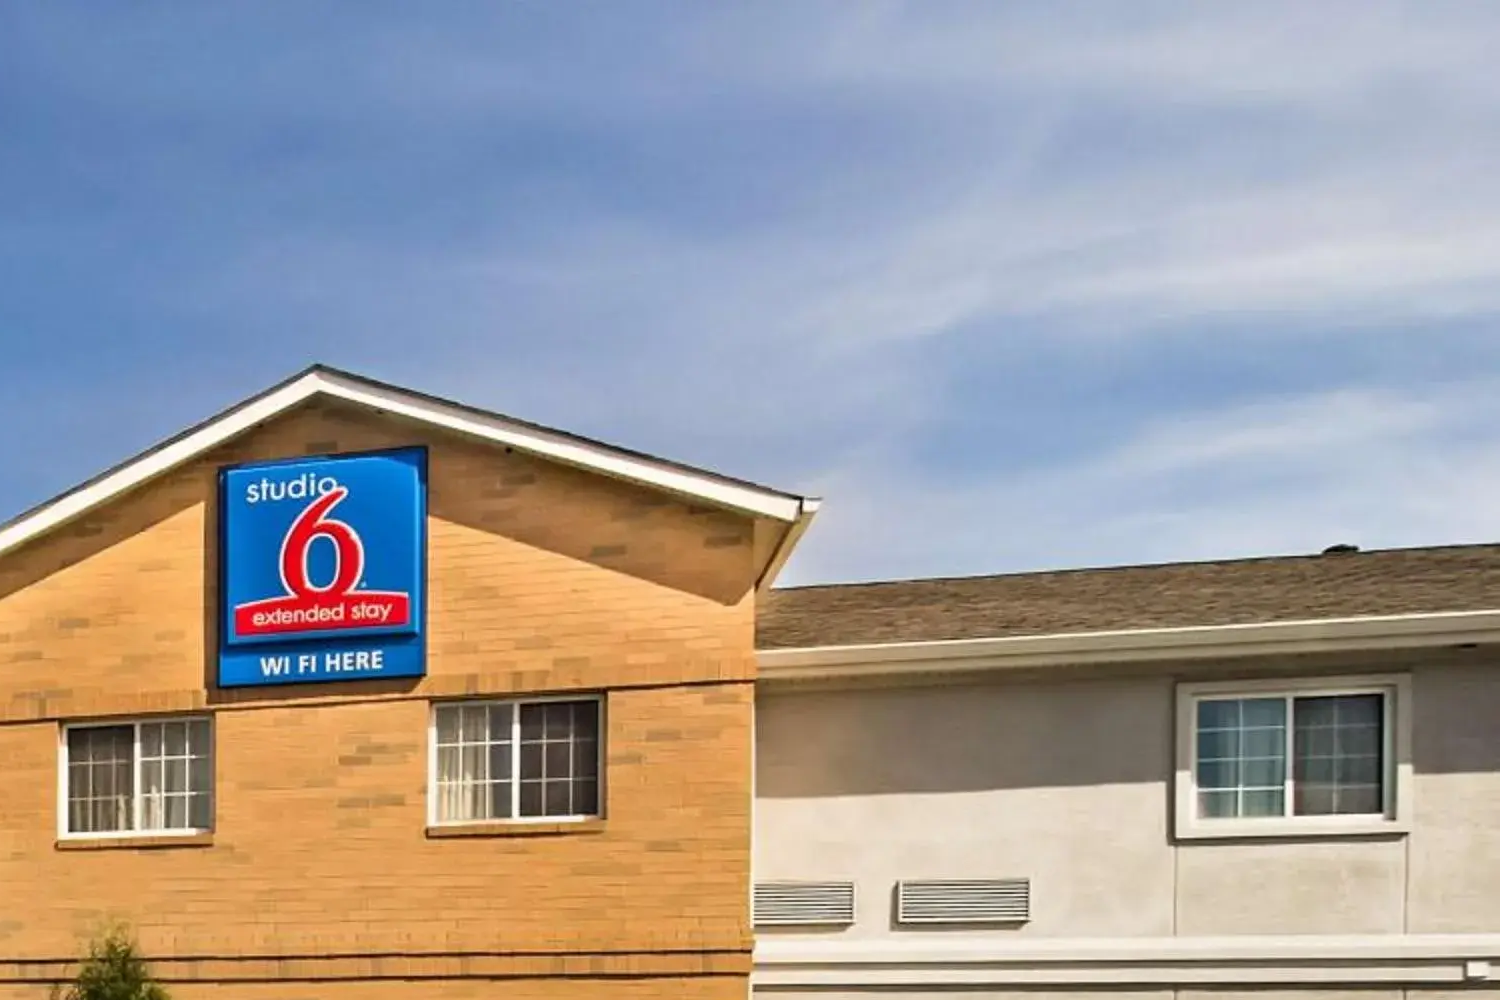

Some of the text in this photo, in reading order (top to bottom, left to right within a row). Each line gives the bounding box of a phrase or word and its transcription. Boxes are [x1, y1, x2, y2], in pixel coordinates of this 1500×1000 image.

[246, 473, 337, 502] studio
[279, 487, 365, 597] 6
[252, 603, 392, 626] extended stay
[260, 651, 384, 676] WI FI HERE
